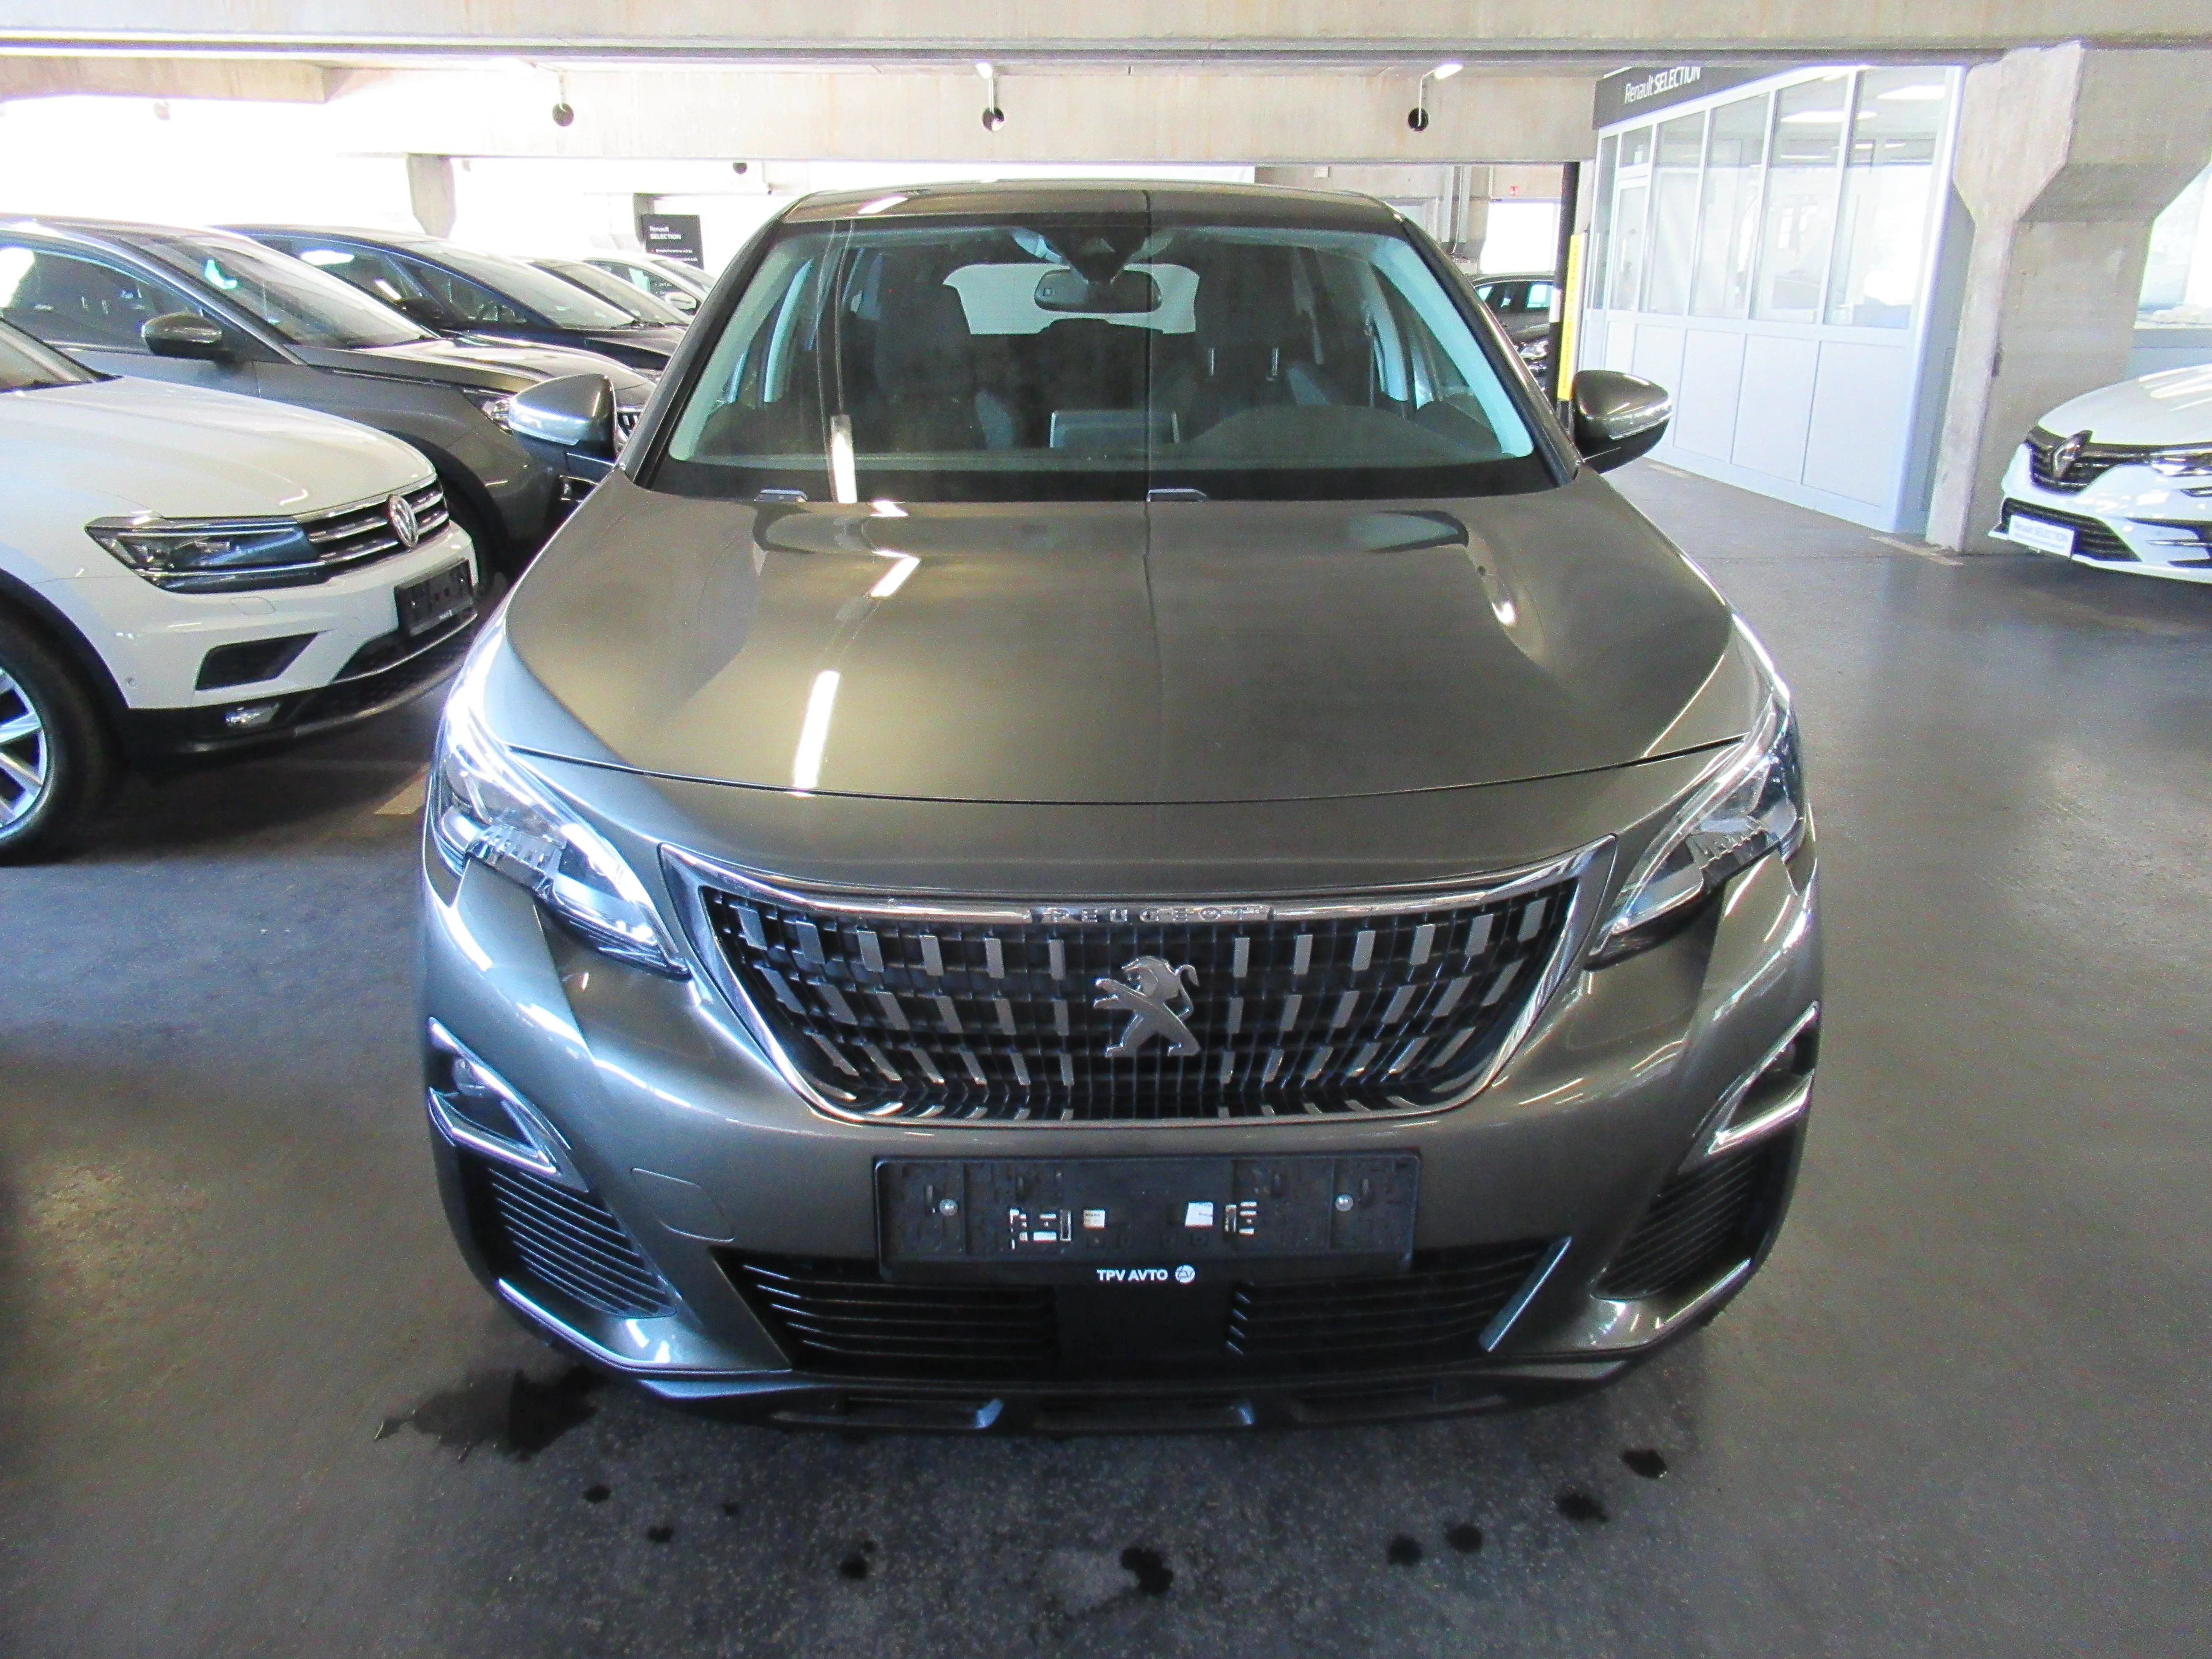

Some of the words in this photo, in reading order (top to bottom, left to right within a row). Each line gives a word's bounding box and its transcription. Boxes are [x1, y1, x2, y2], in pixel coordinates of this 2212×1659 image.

[1625, 75, 1654, 104] Renault
[1654, 66, 1701, 94] SELECTION
[1048, 907, 1249, 923] PEUGEOT
[1096, 1269, 1126, 1281] TPV
[1127, 1269, 1168, 1281] AVTO
